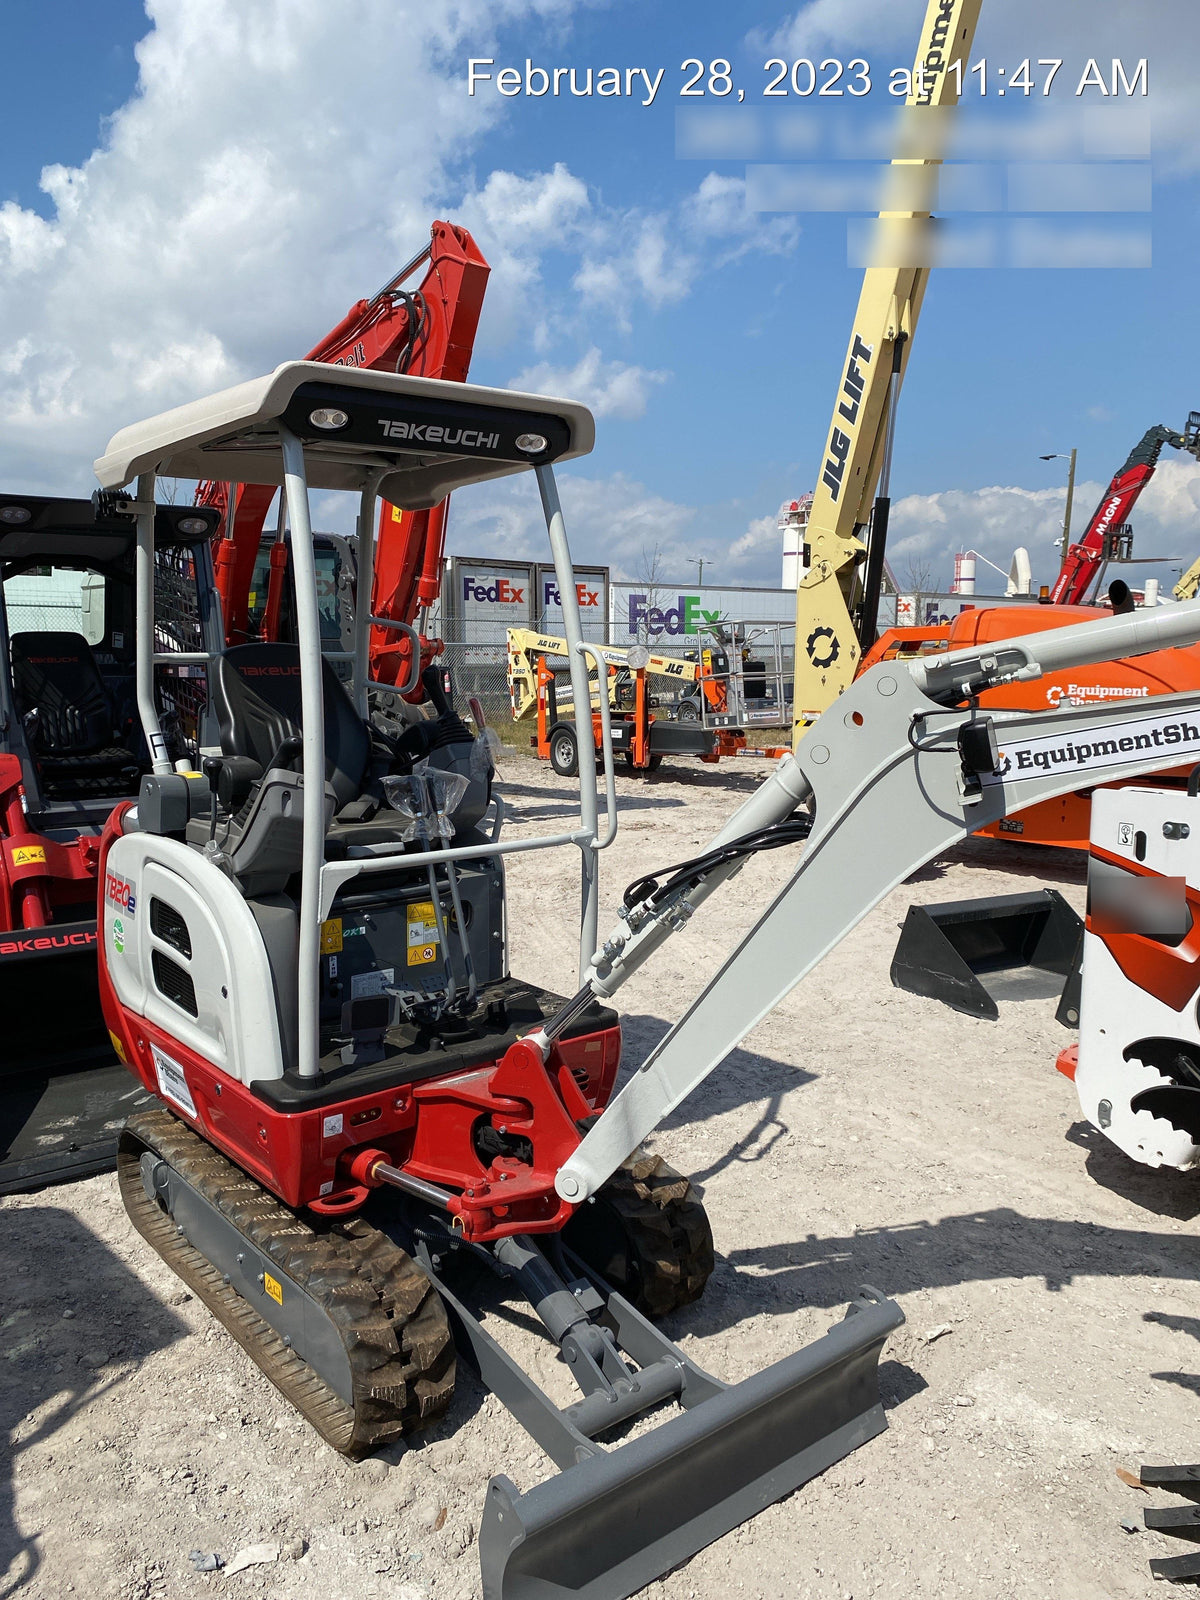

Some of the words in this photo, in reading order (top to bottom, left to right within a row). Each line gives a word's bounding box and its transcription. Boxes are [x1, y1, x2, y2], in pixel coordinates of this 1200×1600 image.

[821, 426, 852, 503] JLG
[838, 332, 873, 426] LIFT
[1095, 496, 1123, 536] MAGNI
[463, 577, 525, 604] FedEx
[544, 582, 599, 607] FeEx
[628, 594, 720, 636] FedEx
[665, 662, 685, 676] JLG
[1067, 683, 1150, 699] Equipment
